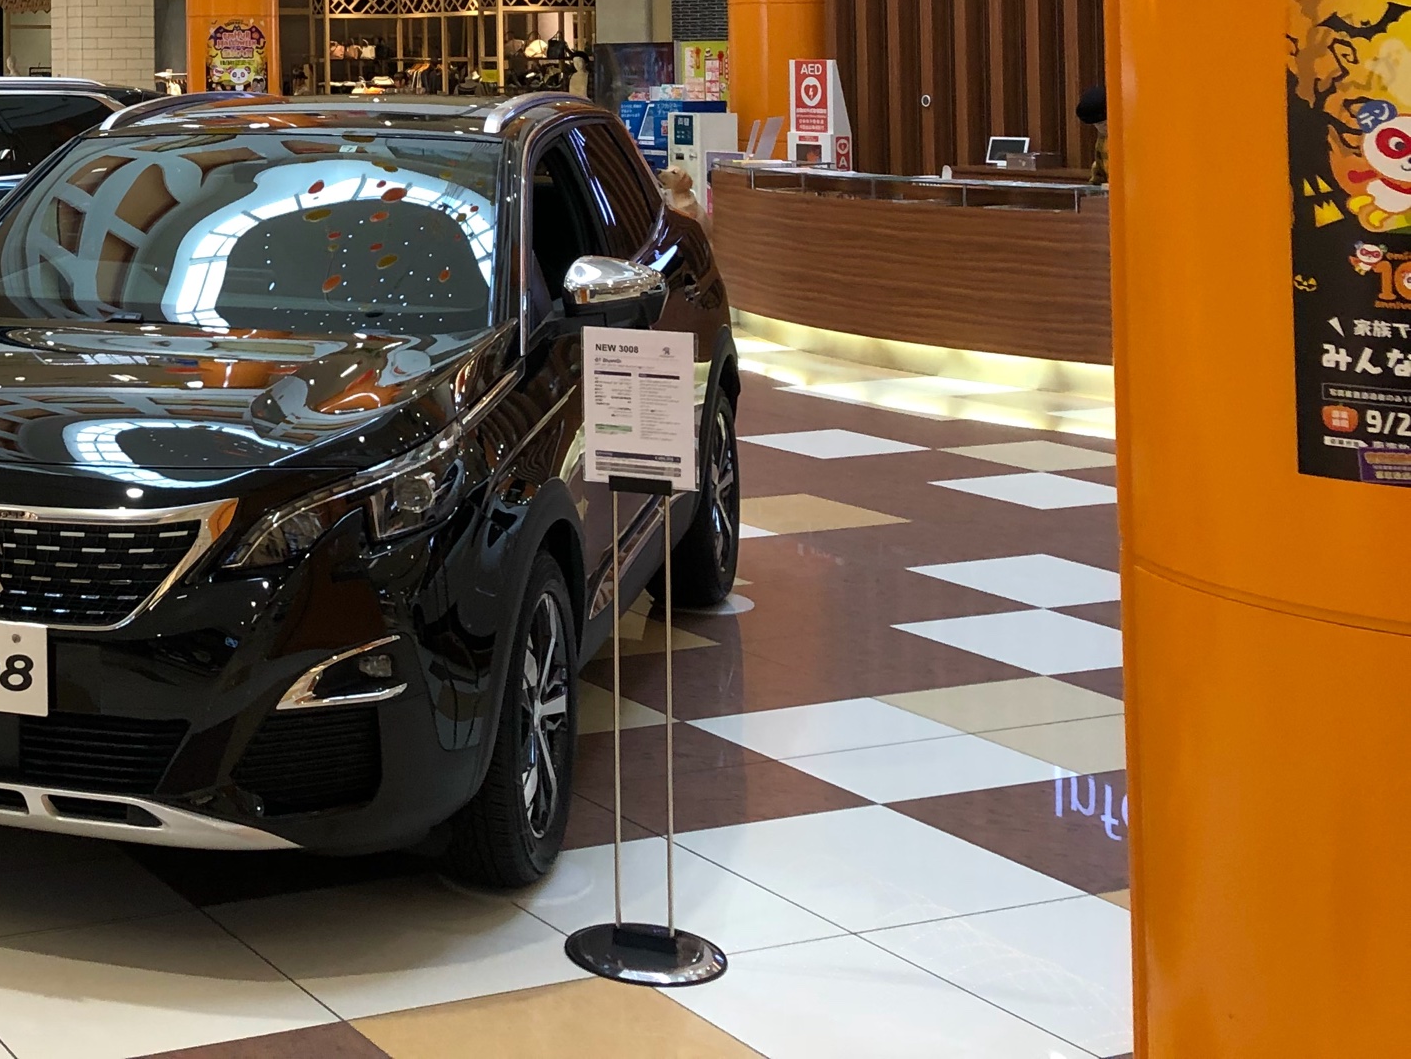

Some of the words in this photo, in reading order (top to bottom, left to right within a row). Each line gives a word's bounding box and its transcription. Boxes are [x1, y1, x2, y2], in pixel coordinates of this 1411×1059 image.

[800, 63, 822, 75] AED
[595, 343, 617, 352] NEW
[618, 345, 639, 354] 3008
